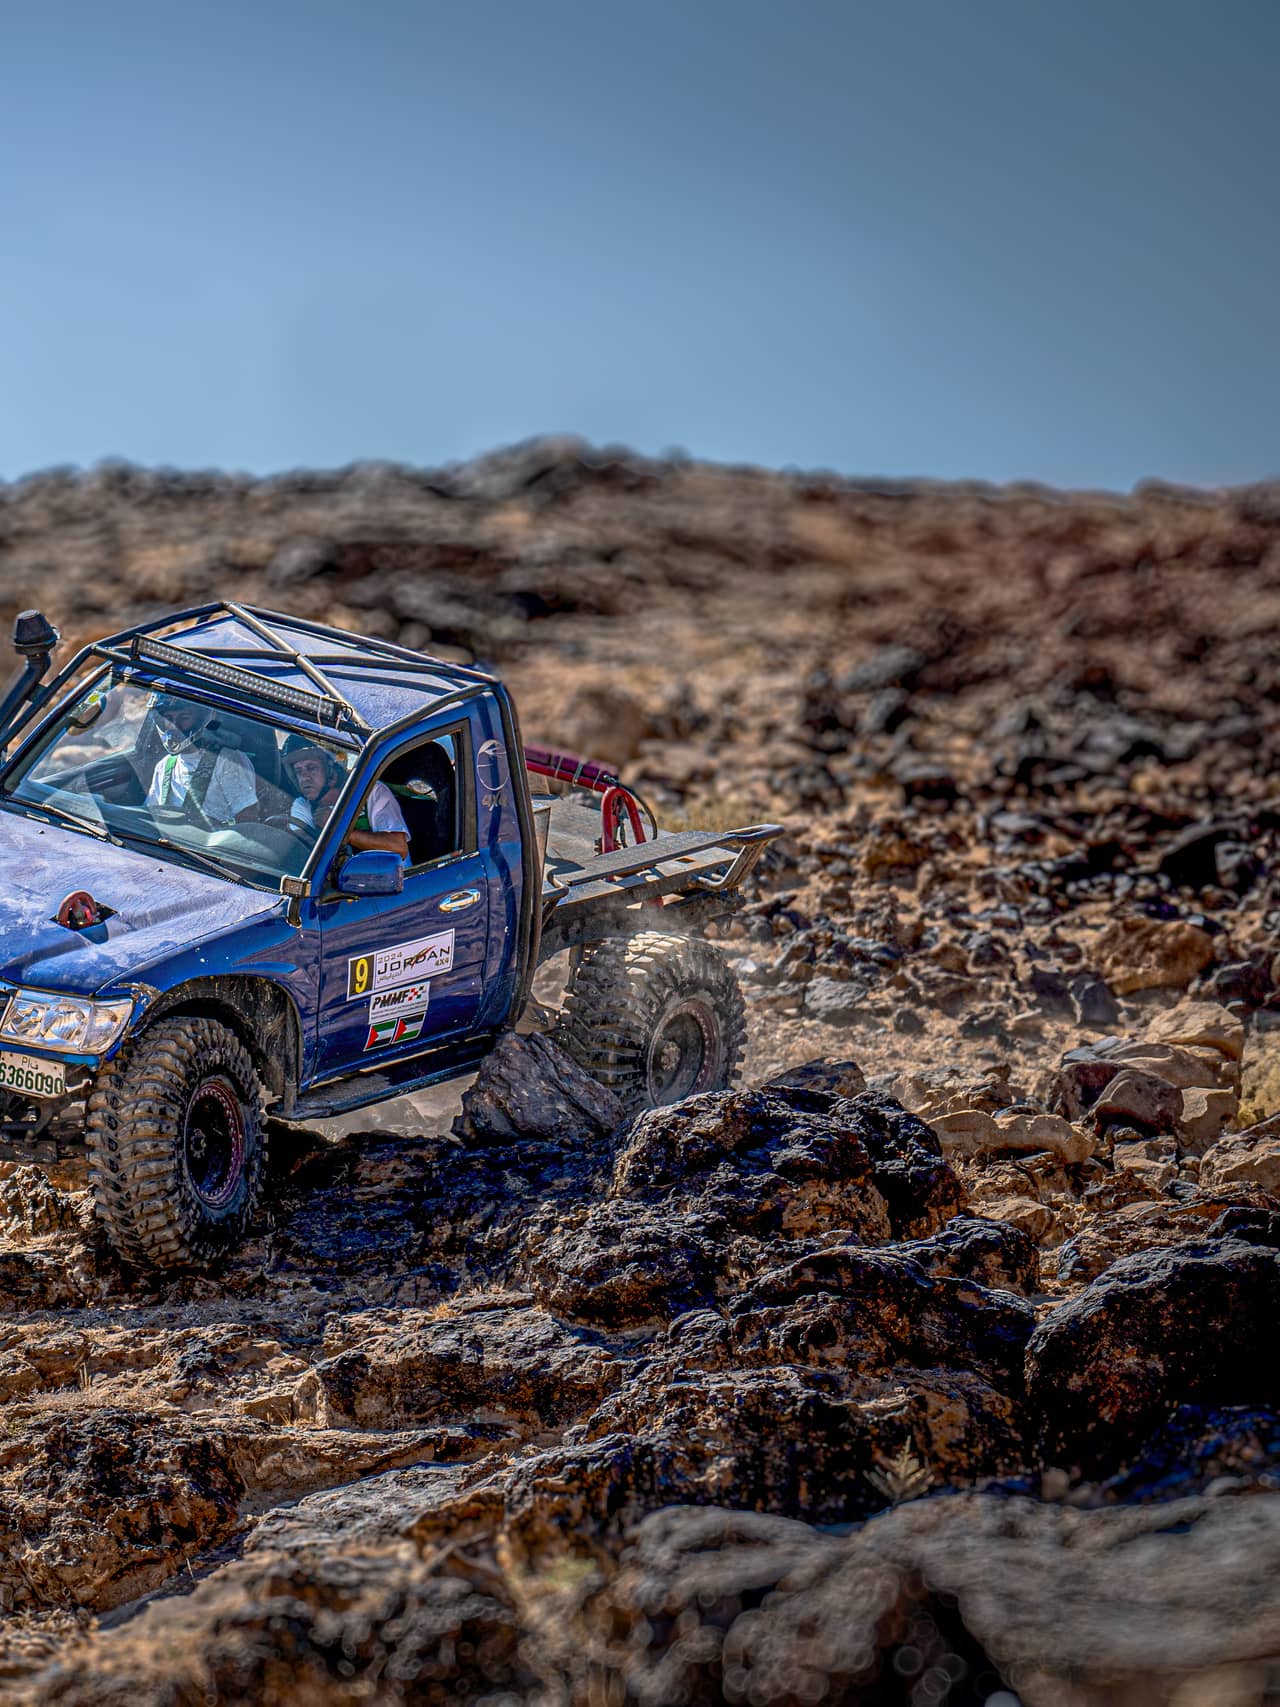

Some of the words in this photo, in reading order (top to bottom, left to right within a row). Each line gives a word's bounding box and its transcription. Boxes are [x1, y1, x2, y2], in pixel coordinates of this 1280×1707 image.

[377, 945, 450, 975] JORDAN
[378, 951, 403, 964] 2024
[355, 958, 369, 993] 9
[372, 988, 410, 1010] PMMF
